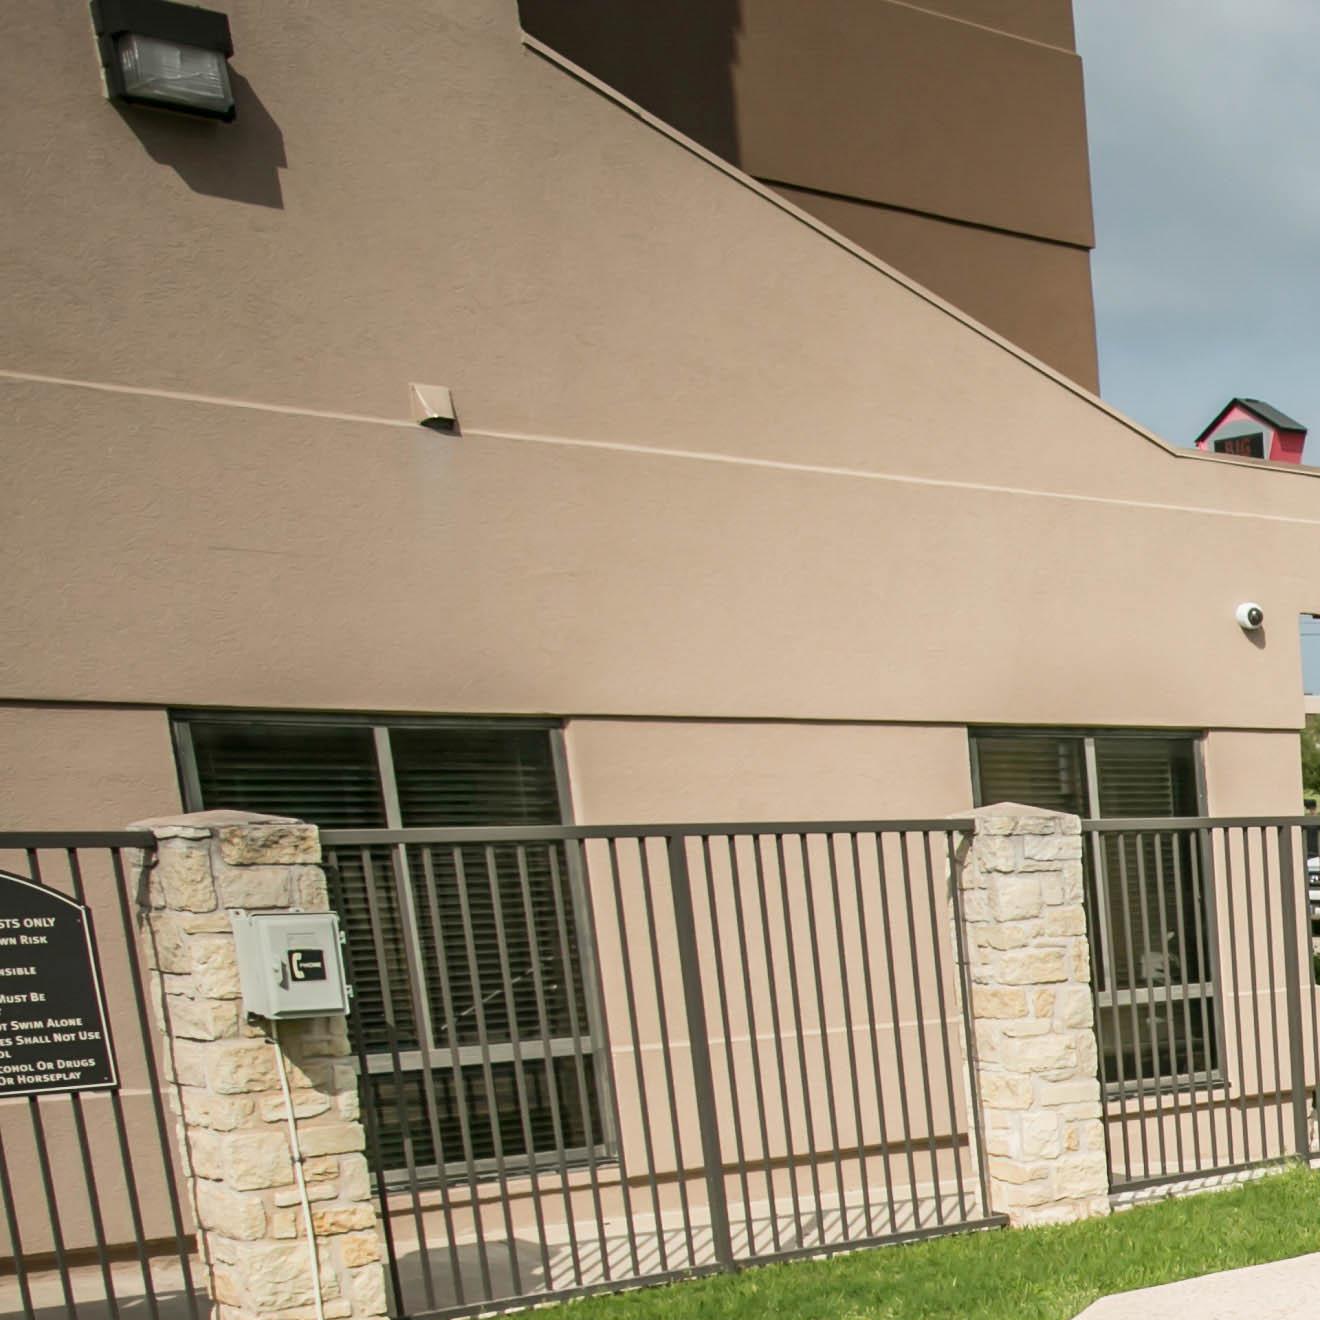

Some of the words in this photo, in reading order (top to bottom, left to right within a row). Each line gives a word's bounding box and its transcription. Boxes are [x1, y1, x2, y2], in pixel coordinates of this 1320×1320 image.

[23, 917, 56, 928] ONLY
[20, 935, 48, 944] RISK
[30, 992, 46, 1002] BE
[11, 1020, 44, 1031] SWIM
[46, 1018, 83, 1028] ALONE
[15, 1035, 52, 1045] SHALL
[52, 1033, 76, 1042] NOT
[78, 1031, 101, 1041] USE
[36, 1061, 54, 1071] OR
[56, 1058, 96, 1069] DRUGS
[17, 1072, 81, 1084] HORSEPLAY
